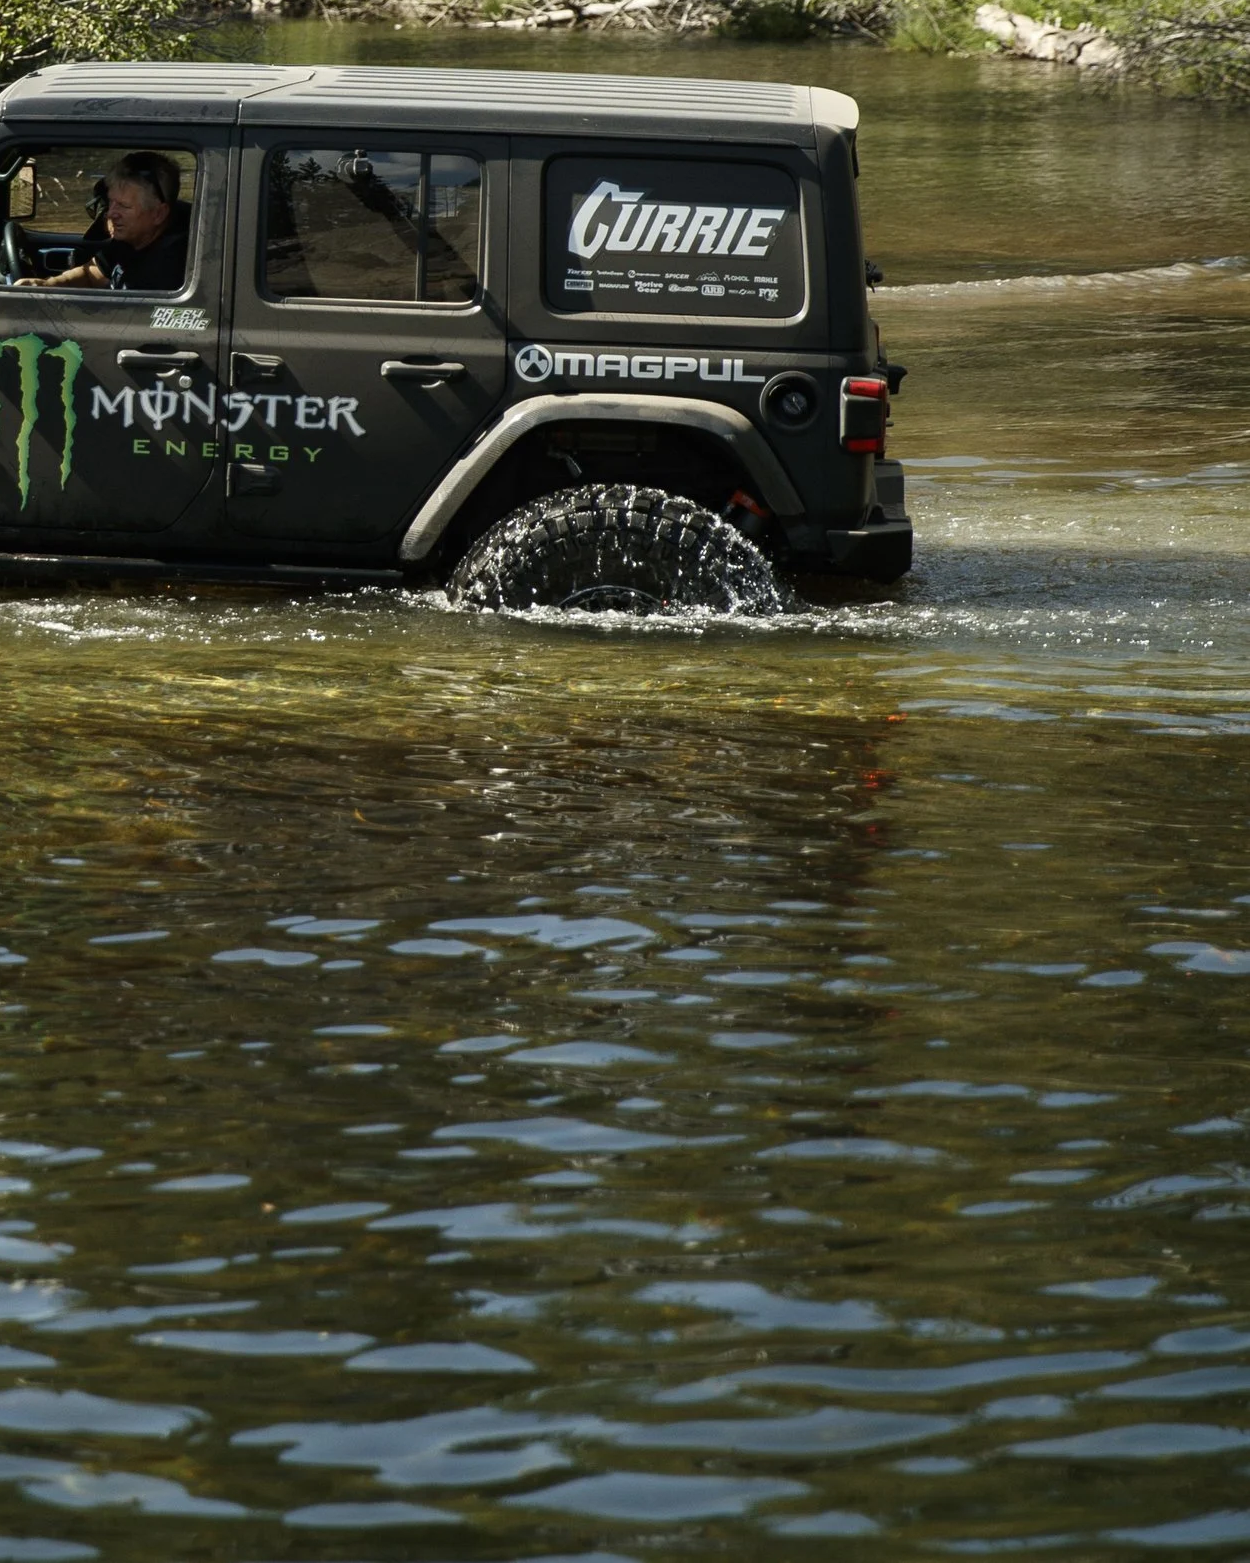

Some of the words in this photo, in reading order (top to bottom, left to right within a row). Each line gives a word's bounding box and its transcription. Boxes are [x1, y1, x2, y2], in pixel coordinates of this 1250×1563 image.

[568, 181, 786, 259] CURRIE
[554, 352, 766, 383] MAGPUL
[133, 439, 323, 463] ENERGY
